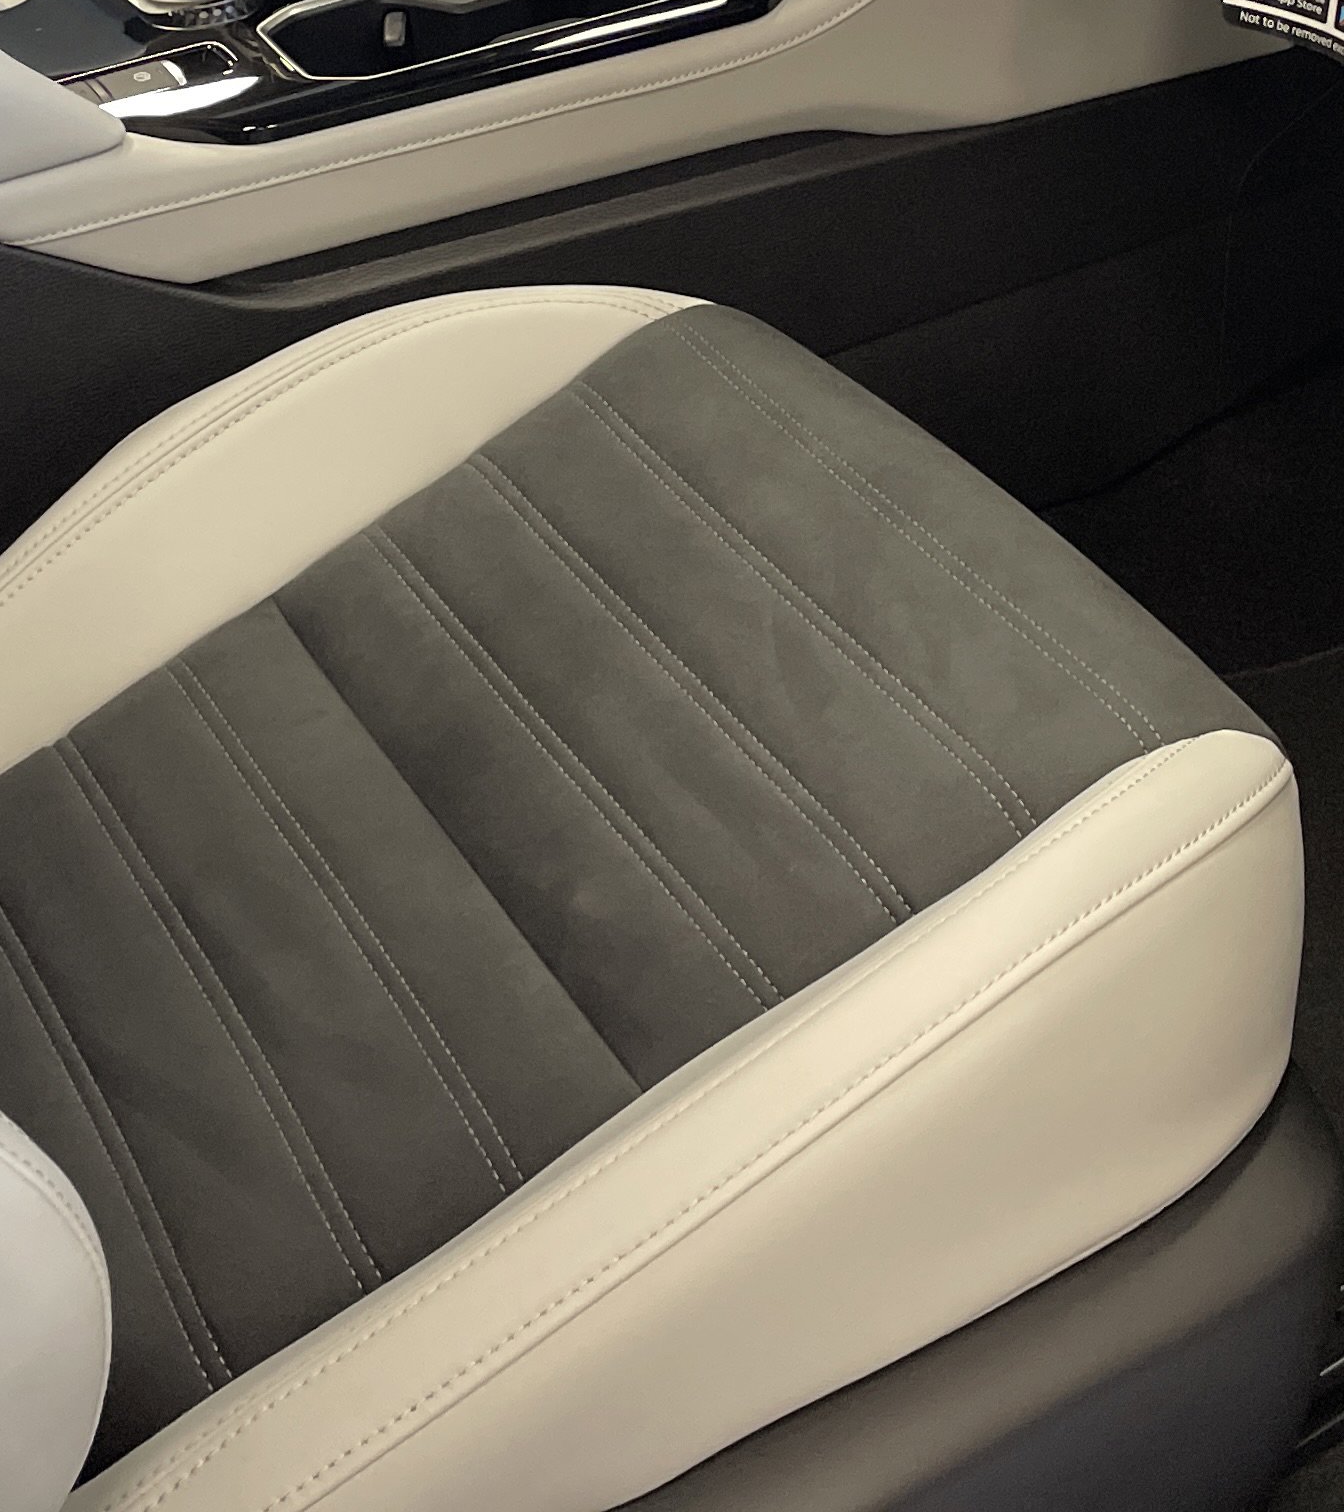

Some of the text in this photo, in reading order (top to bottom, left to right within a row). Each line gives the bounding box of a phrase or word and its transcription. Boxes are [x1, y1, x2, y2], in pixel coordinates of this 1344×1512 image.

[1239, 10, 1260, 25] Not
[1262, 16, 1275, 29] to
[1276, 19, 1290, 33] be
[1291, 26, 1333, 48] removed
